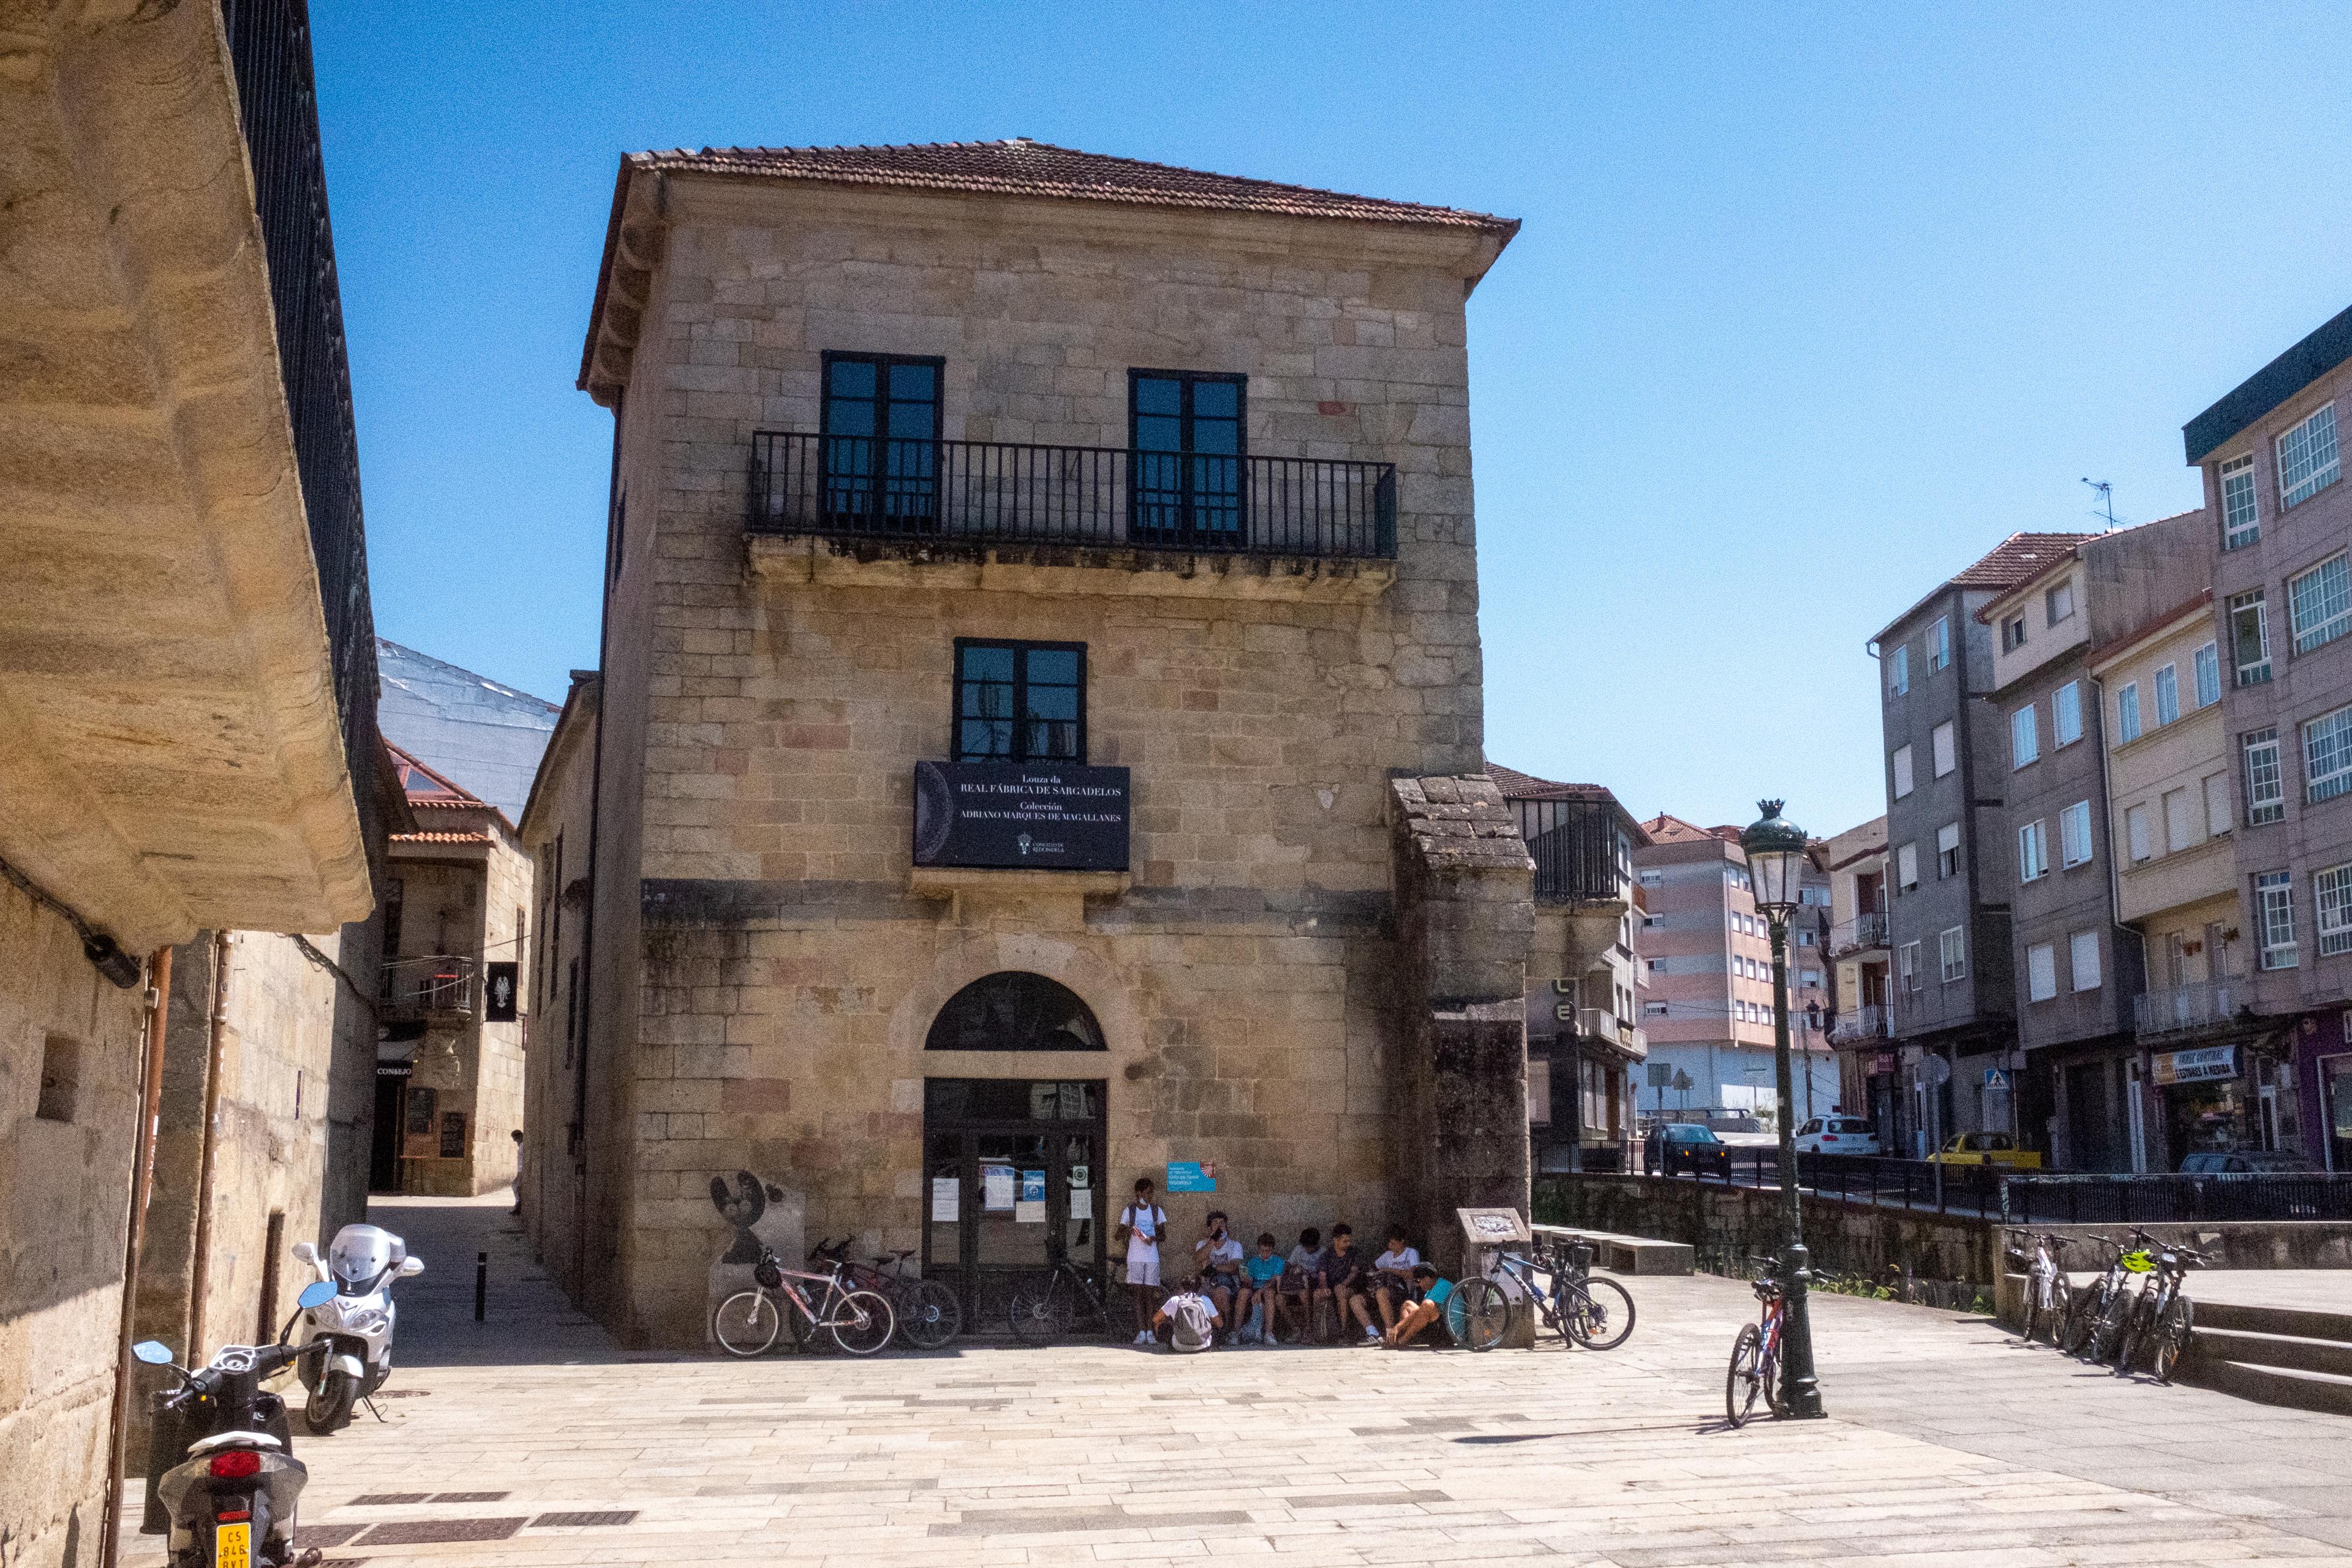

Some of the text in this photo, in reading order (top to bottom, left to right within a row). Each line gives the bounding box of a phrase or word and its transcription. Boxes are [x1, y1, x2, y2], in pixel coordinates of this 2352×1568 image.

[1023, 774, 1048, 783] Louza
[961, 783, 1121, 796] REAL FÁBRICA DE SARGADELOS
[1020, 801, 1062, 811] Colección
[1003, 811, 1046, 821] MARQUES
[1048, 812, 1060, 821] DE
[1063, 813, 1121, 822] MAGALLANES
